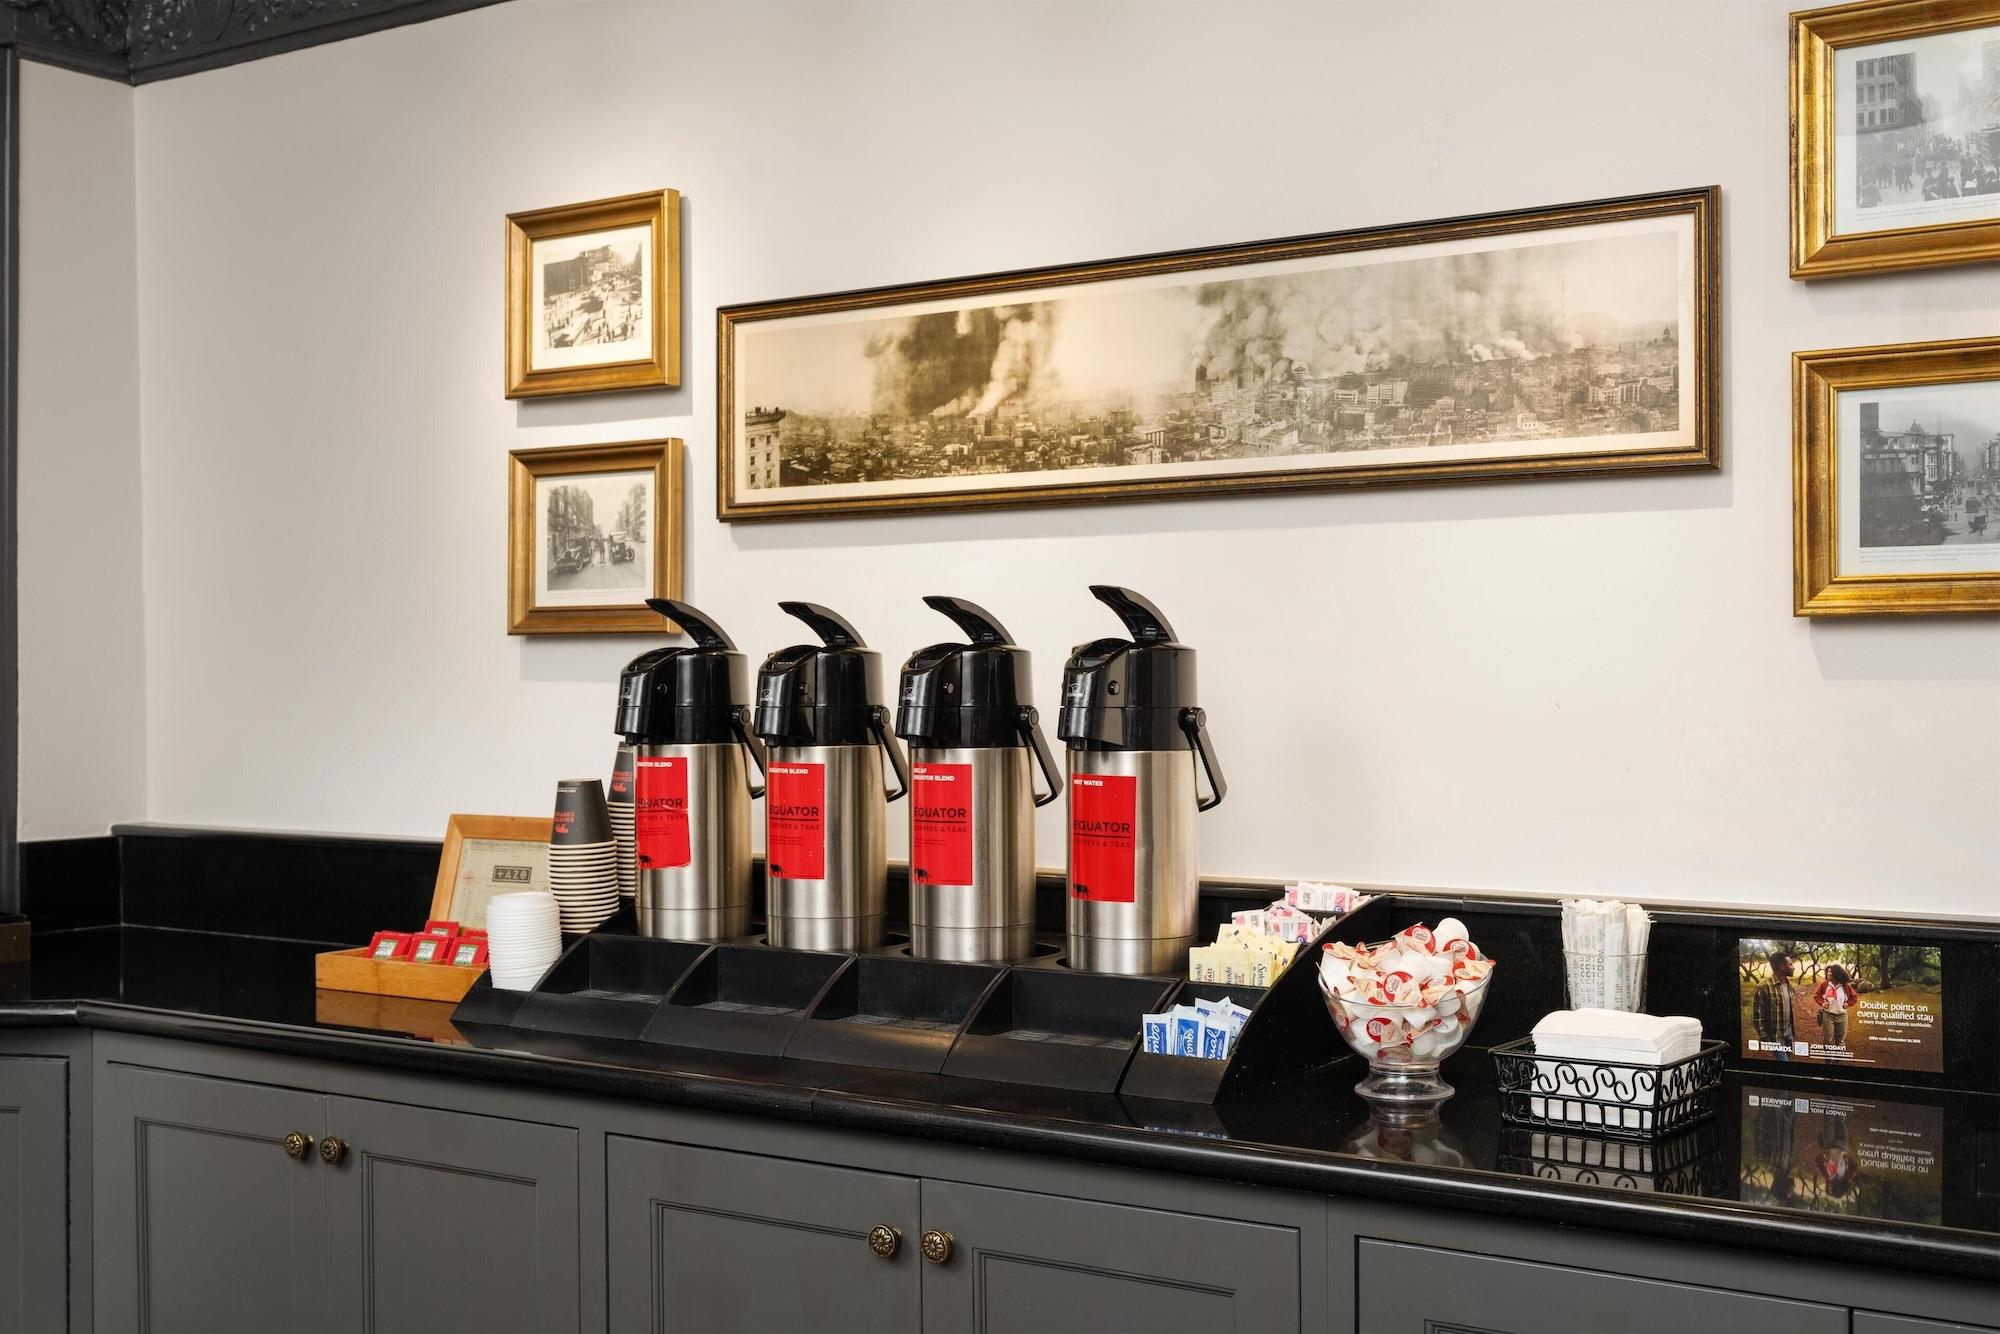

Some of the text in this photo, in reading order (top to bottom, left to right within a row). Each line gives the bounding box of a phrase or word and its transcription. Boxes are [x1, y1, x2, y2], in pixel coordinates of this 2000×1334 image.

[769, 804, 819, 817] EQUATOR
[914, 806, 966, 818] EQUATOR
[1073, 820, 1131, 833] EQUATOR
[1616, 983, 1623, 993] UP
[1616, 997, 1622, 1005] IT
[1860, 1001, 1888, 1011] Double
[1890, 1002, 1915, 1013] points
[1856, 1010, 1934, 1022] every qualified stay
[1148, 1023, 1160, 1054] equ
[1206, 1029, 1221, 1059] ual
